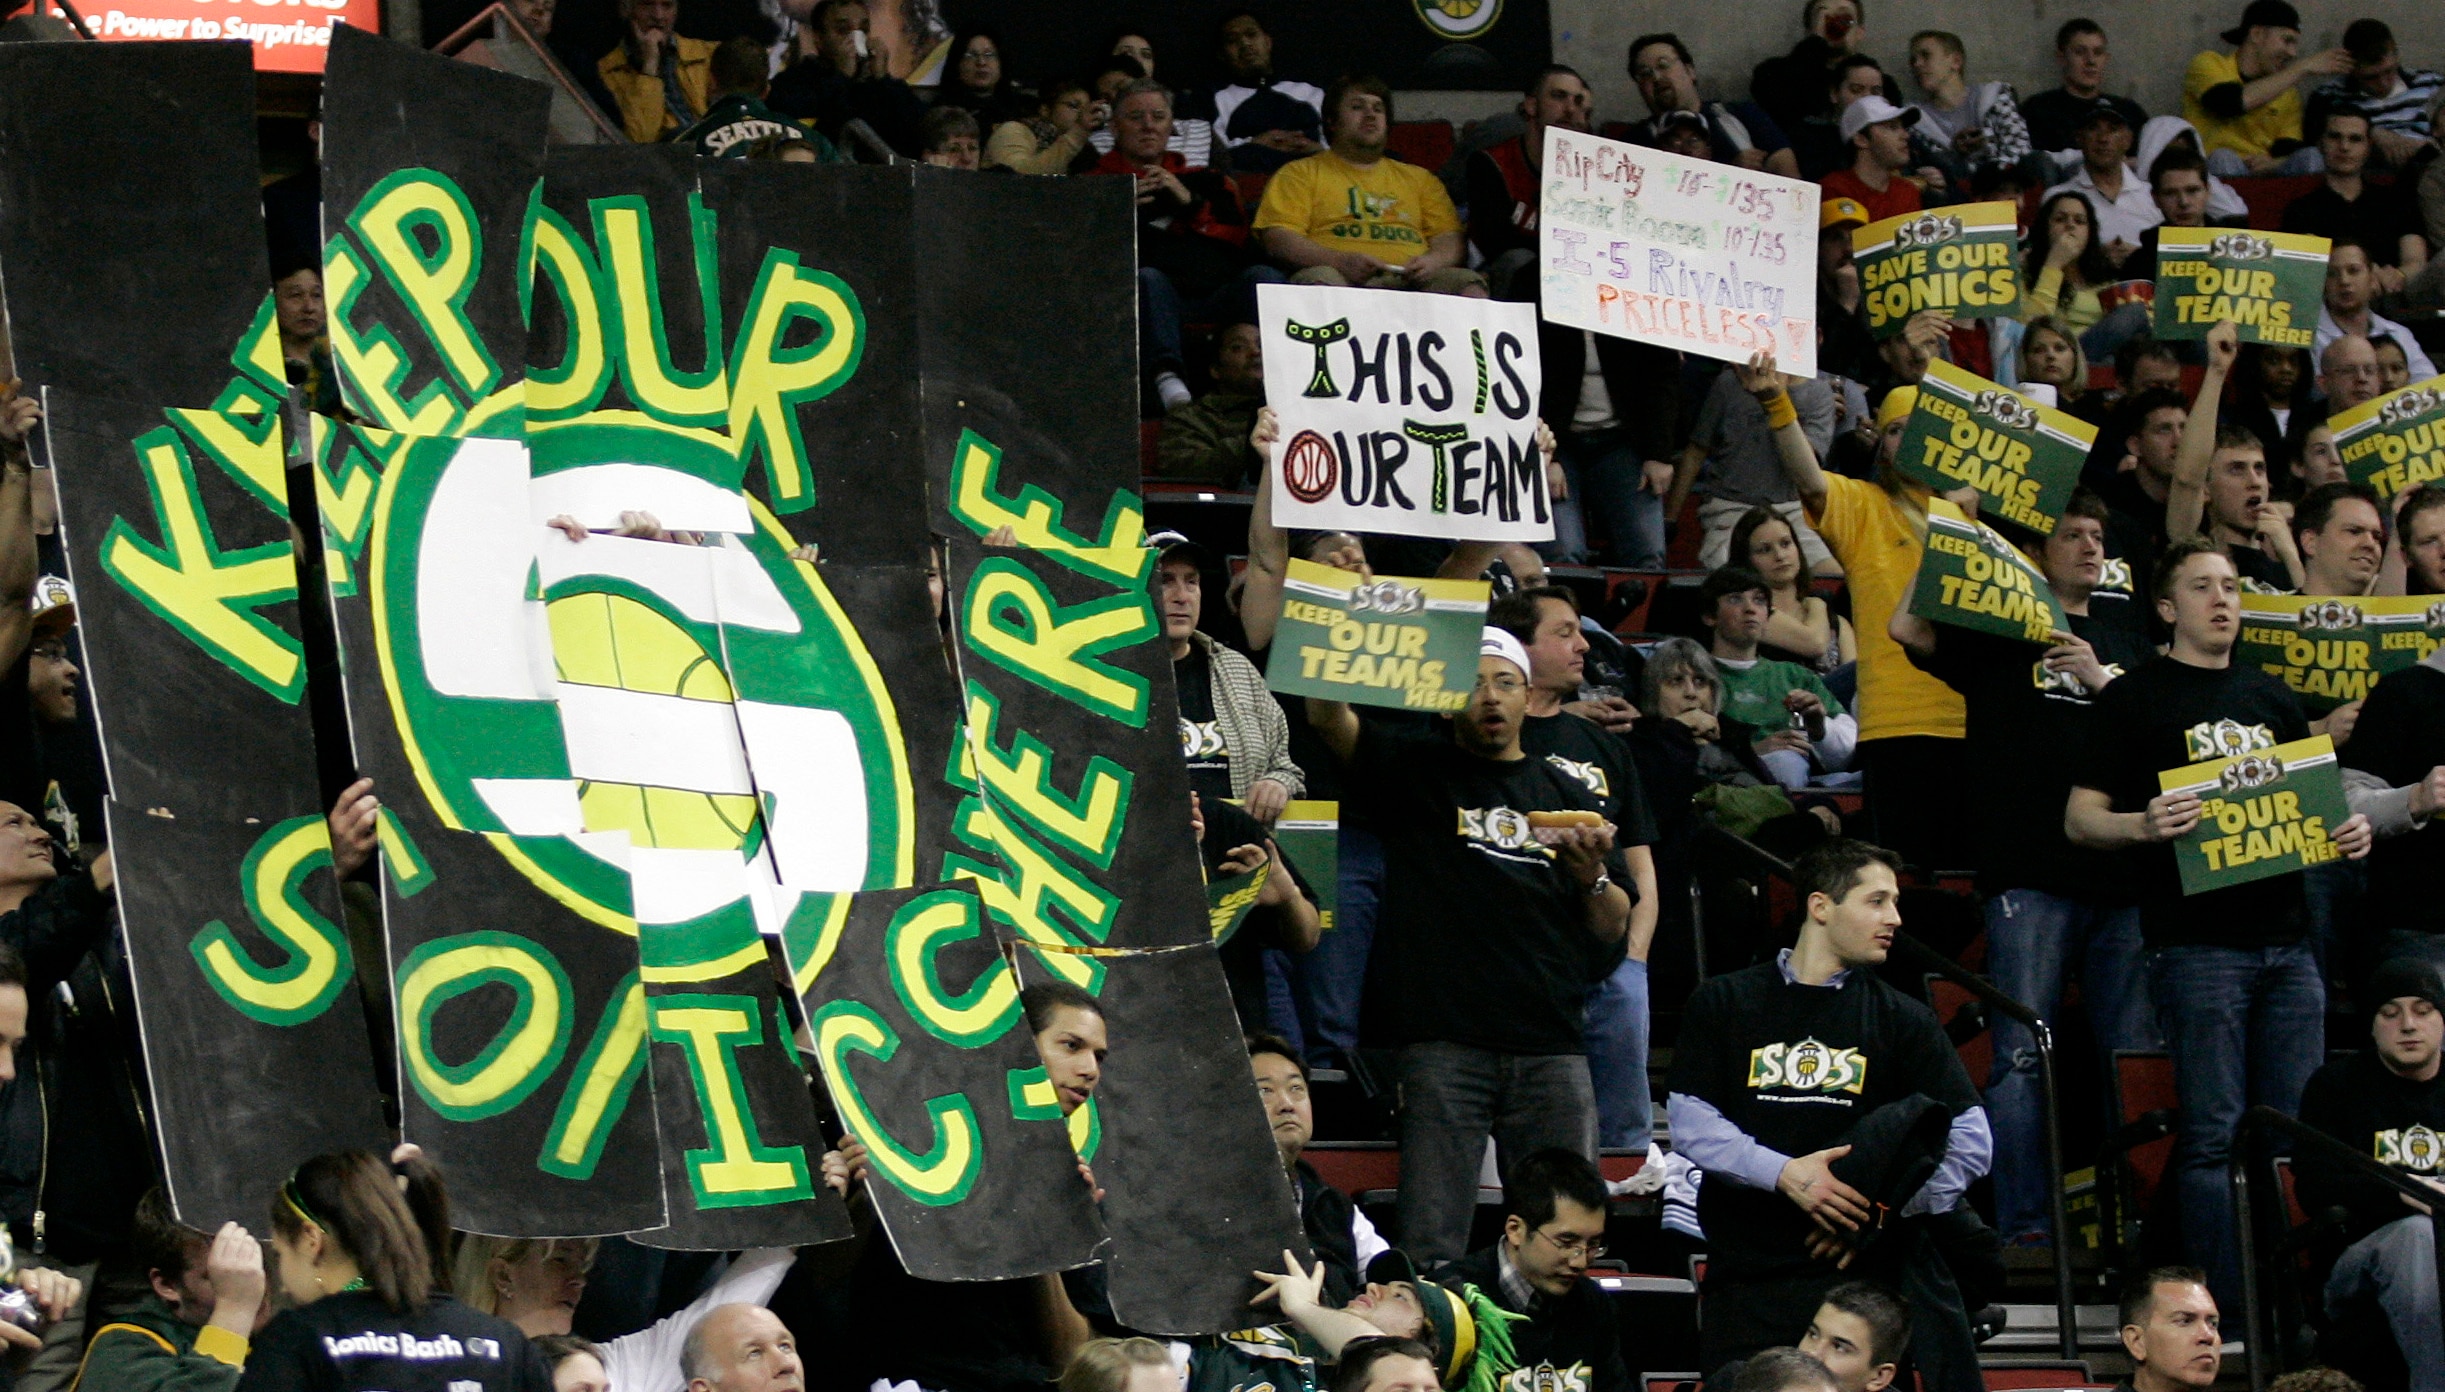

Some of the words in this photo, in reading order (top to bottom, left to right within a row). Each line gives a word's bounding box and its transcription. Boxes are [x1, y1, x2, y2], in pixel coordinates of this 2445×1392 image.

[105, 10, 185, 38] Power
[190, 17, 220, 40] to
[223, 16, 331, 49] Surprise
[705, 119, 803, 157] SEATTE
[1894, 203, 1962, 250] SOS
[2211, 233, 2273, 261] SOS
[1863, 250, 1927, 290] SAVE
[1936, 242, 2010, 270] OUR
[2160, 260, 2210, 277] KEEP
[2195, 266, 2277, 299] OUR
[1866, 269, 2017, 328] SONICS
[2175, 294, 2293, 328] TEAMS
[2258, 323, 2314, 346] HERE
[1285, 316, 1453, 412] THIS
[1470, 328, 1531, 420] IS
[1918, 392, 1970, 424] KEEP
[1974, 389, 2040, 431] SOS
[2381, 388, 2438, 426] SOS
[1950, 418, 2033, 476] OUR
[2342, 433, 2386, 464] KEEP
[1283, 429, 1416, 510] OUR
[1403, 417, 1549, 525] TEAM
[1922, 435, 2042, 508] TEAMS
[2001, 497, 2056, 534] HERE
[1929, 532, 1978, 558] KEEP
[1965, 551, 2036, 597] OUR
[1284, 600, 1348, 627] KEEP
[1350, 580, 1423, 615] SOS
[1940, 574, 2054, 628] TEAMS
[2299, 599, 2362, 631] SOS
[1329, 620, 1428, 660] OUR
[2024, 623, 2068, 646] HE
[2243, 627, 2299, 646] KEEP
[2381, 631, 2428, 650] KEEP
[1300, 645, 1448, 690] TEAMS
[2285, 639, 2370, 670] OUR
[1404, 687, 1470, 710] HERE
[2222, 756, 2281, 793] SOS
[2217, 790, 2303, 836] OUR
[2201, 815, 2329, 871] TEAMS
[1757, 1036, 1860, 1093] SOS
[400, 1332, 464, 1359] Bash
